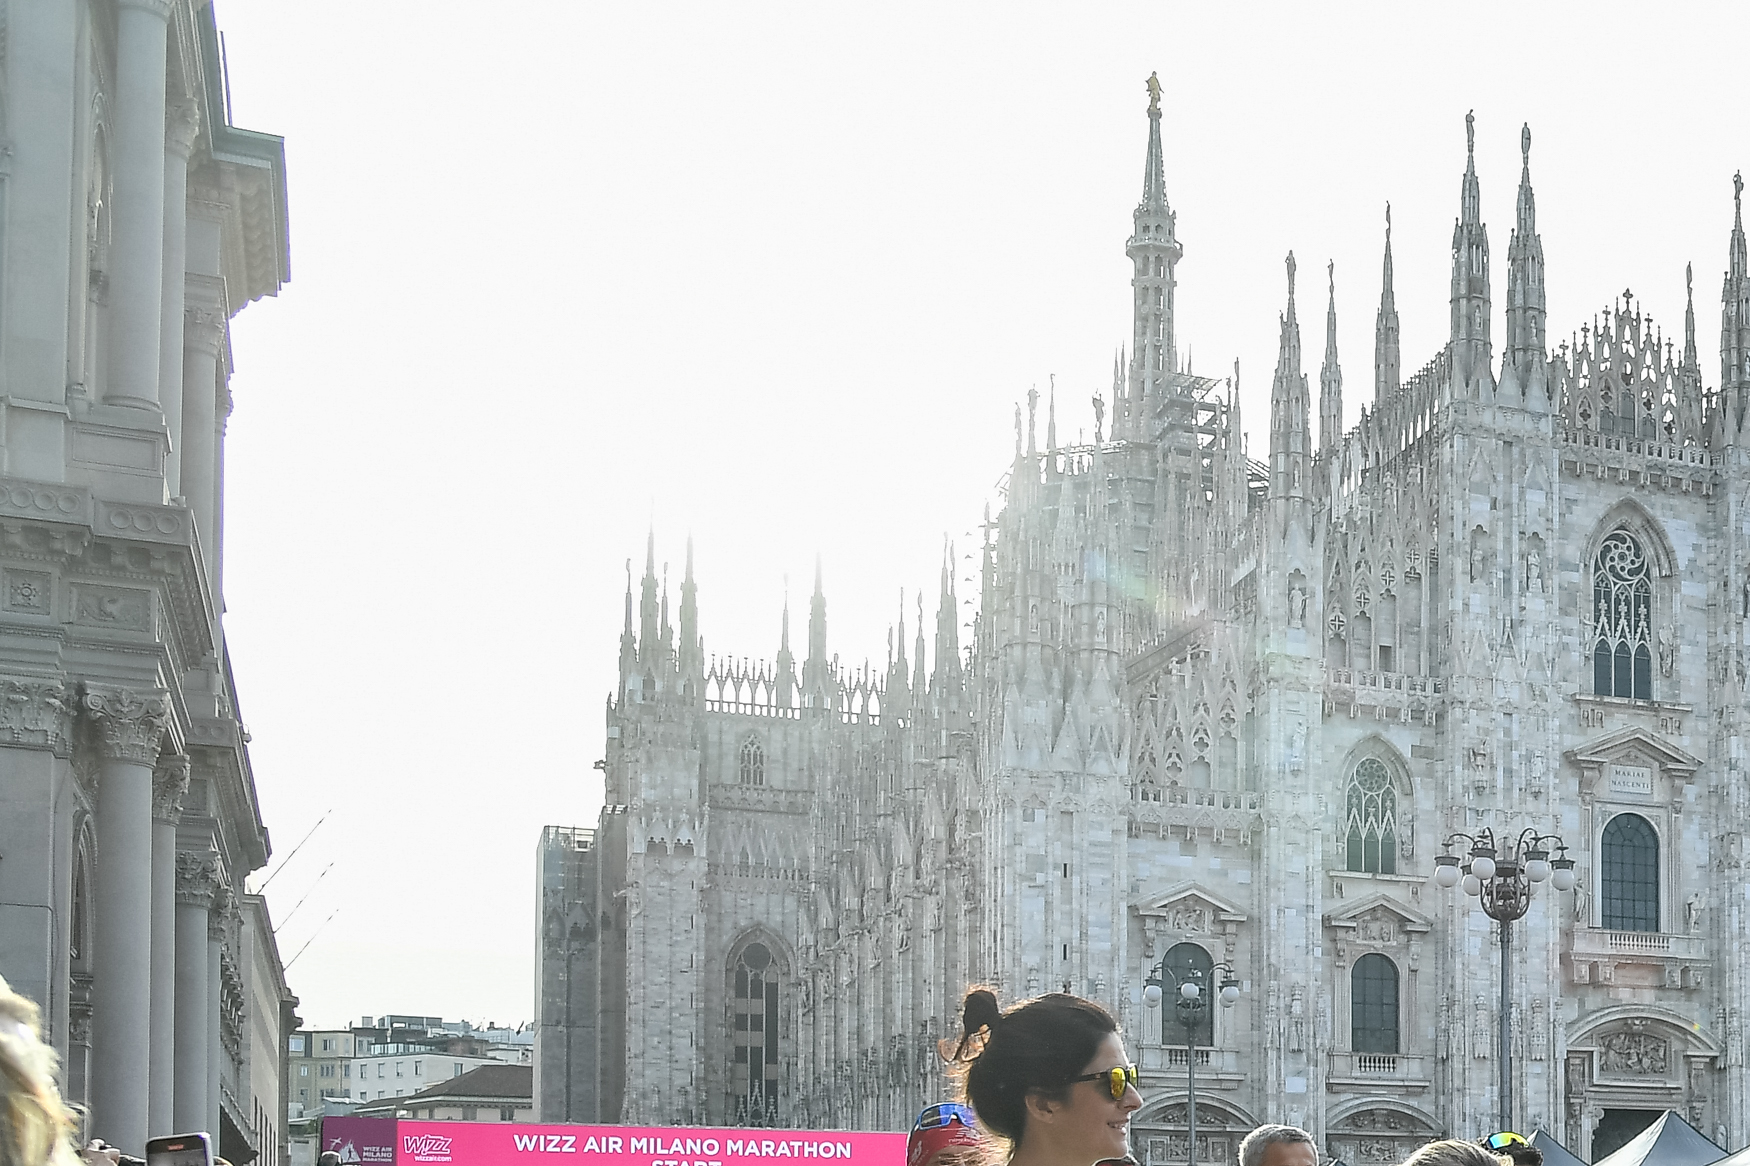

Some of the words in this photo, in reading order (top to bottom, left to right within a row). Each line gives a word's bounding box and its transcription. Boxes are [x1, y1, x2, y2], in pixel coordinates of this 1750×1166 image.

[1615, 769, 1645, 779] MARIAE
[1611, 779, 1650, 789] NASCENTI
[513, 1134, 576, 1153] WIZZ
[583, 1136, 623, 1154] AIR
[630, 1137, 720, 1156] MILANO
[726, 1139, 852, 1159] MARATHON
